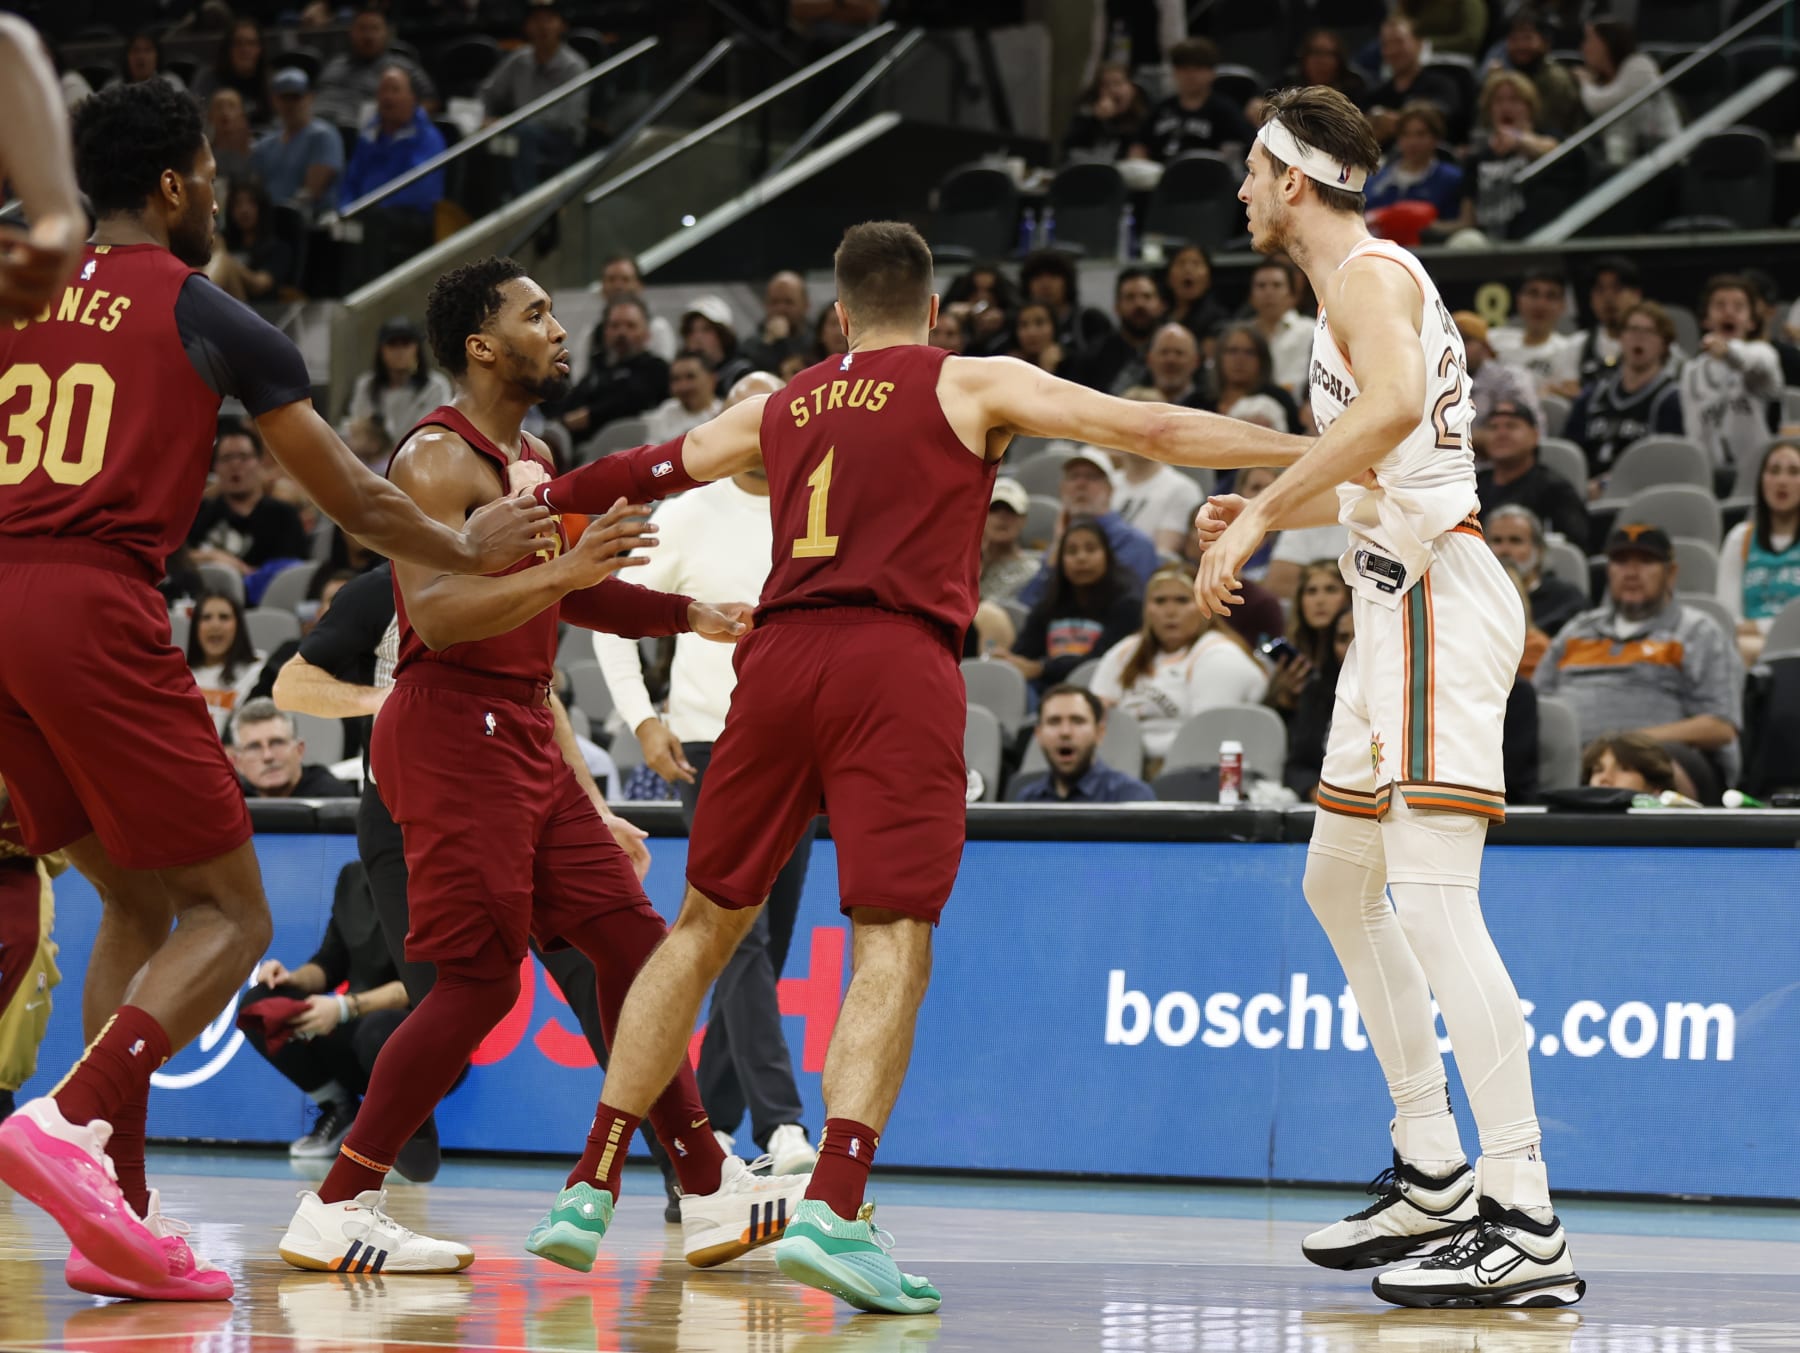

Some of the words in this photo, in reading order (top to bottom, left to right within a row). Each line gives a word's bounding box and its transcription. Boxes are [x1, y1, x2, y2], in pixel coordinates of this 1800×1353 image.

[13, 287, 131, 332] NES
[0, 362, 116, 486] 30
[790, 378, 895, 428] STRUS
[1431, 346, 1475, 450] 2
[791, 445, 839, 558] 1
[1104, 969, 1735, 1061] boscht.com
